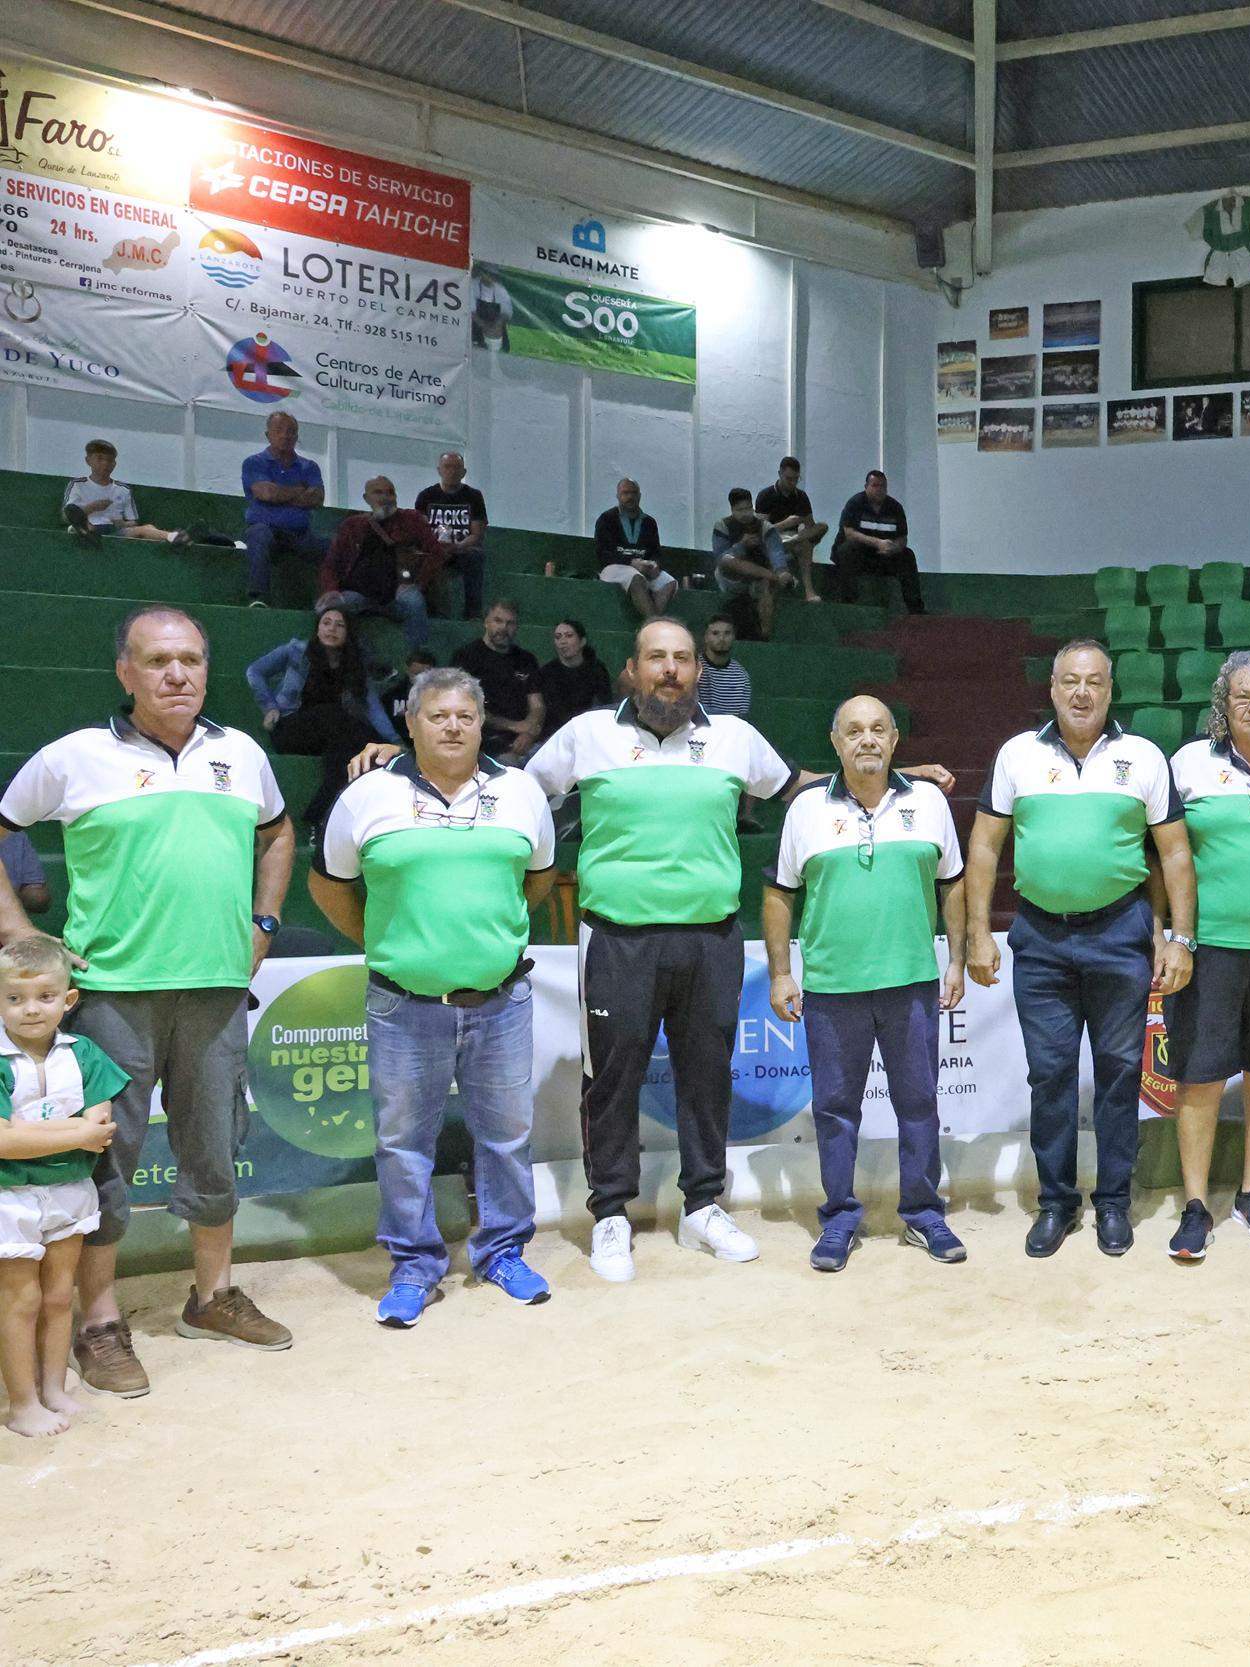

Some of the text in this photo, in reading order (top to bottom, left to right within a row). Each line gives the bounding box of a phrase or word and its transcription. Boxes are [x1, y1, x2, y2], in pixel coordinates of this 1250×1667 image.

[15, 91, 114, 152] Faro
[339, 167, 362, 186] DE
[368, 175, 454, 208] SERVICIO
[0, 202, 29, 219] 66
[7, 178, 178, 230] SERVICIOS EN GENERAL
[248, 175, 462, 243] CEPSA TAHICHE
[50, 218, 99, 243] 24 hrs.
[7, 239, 58, 256] Desatascos
[16, 250, 52, 265] Pinturas
[117, 242, 168, 266] J.M.C.
[536, 246, 639, 281] BEACH MATE
[96, 280, 173, 302] jmc reformas
[283, 247, 462, 311] LOTERIAS
[283, 283, 461, 327] PUERTO DEL CARMEN
[364, 324, 387, 338] 928
[391, 329, 413, 342] 515
[417, 334, 438, 348] 116
[4, 348, 40, 366] DE
[315, 352, 379, 377] Centros
[385, 364, 404, 381] de
[315, 371, 447, 406] Cultura y Turismo
[272, 1023, 369, 1047] Compromet
